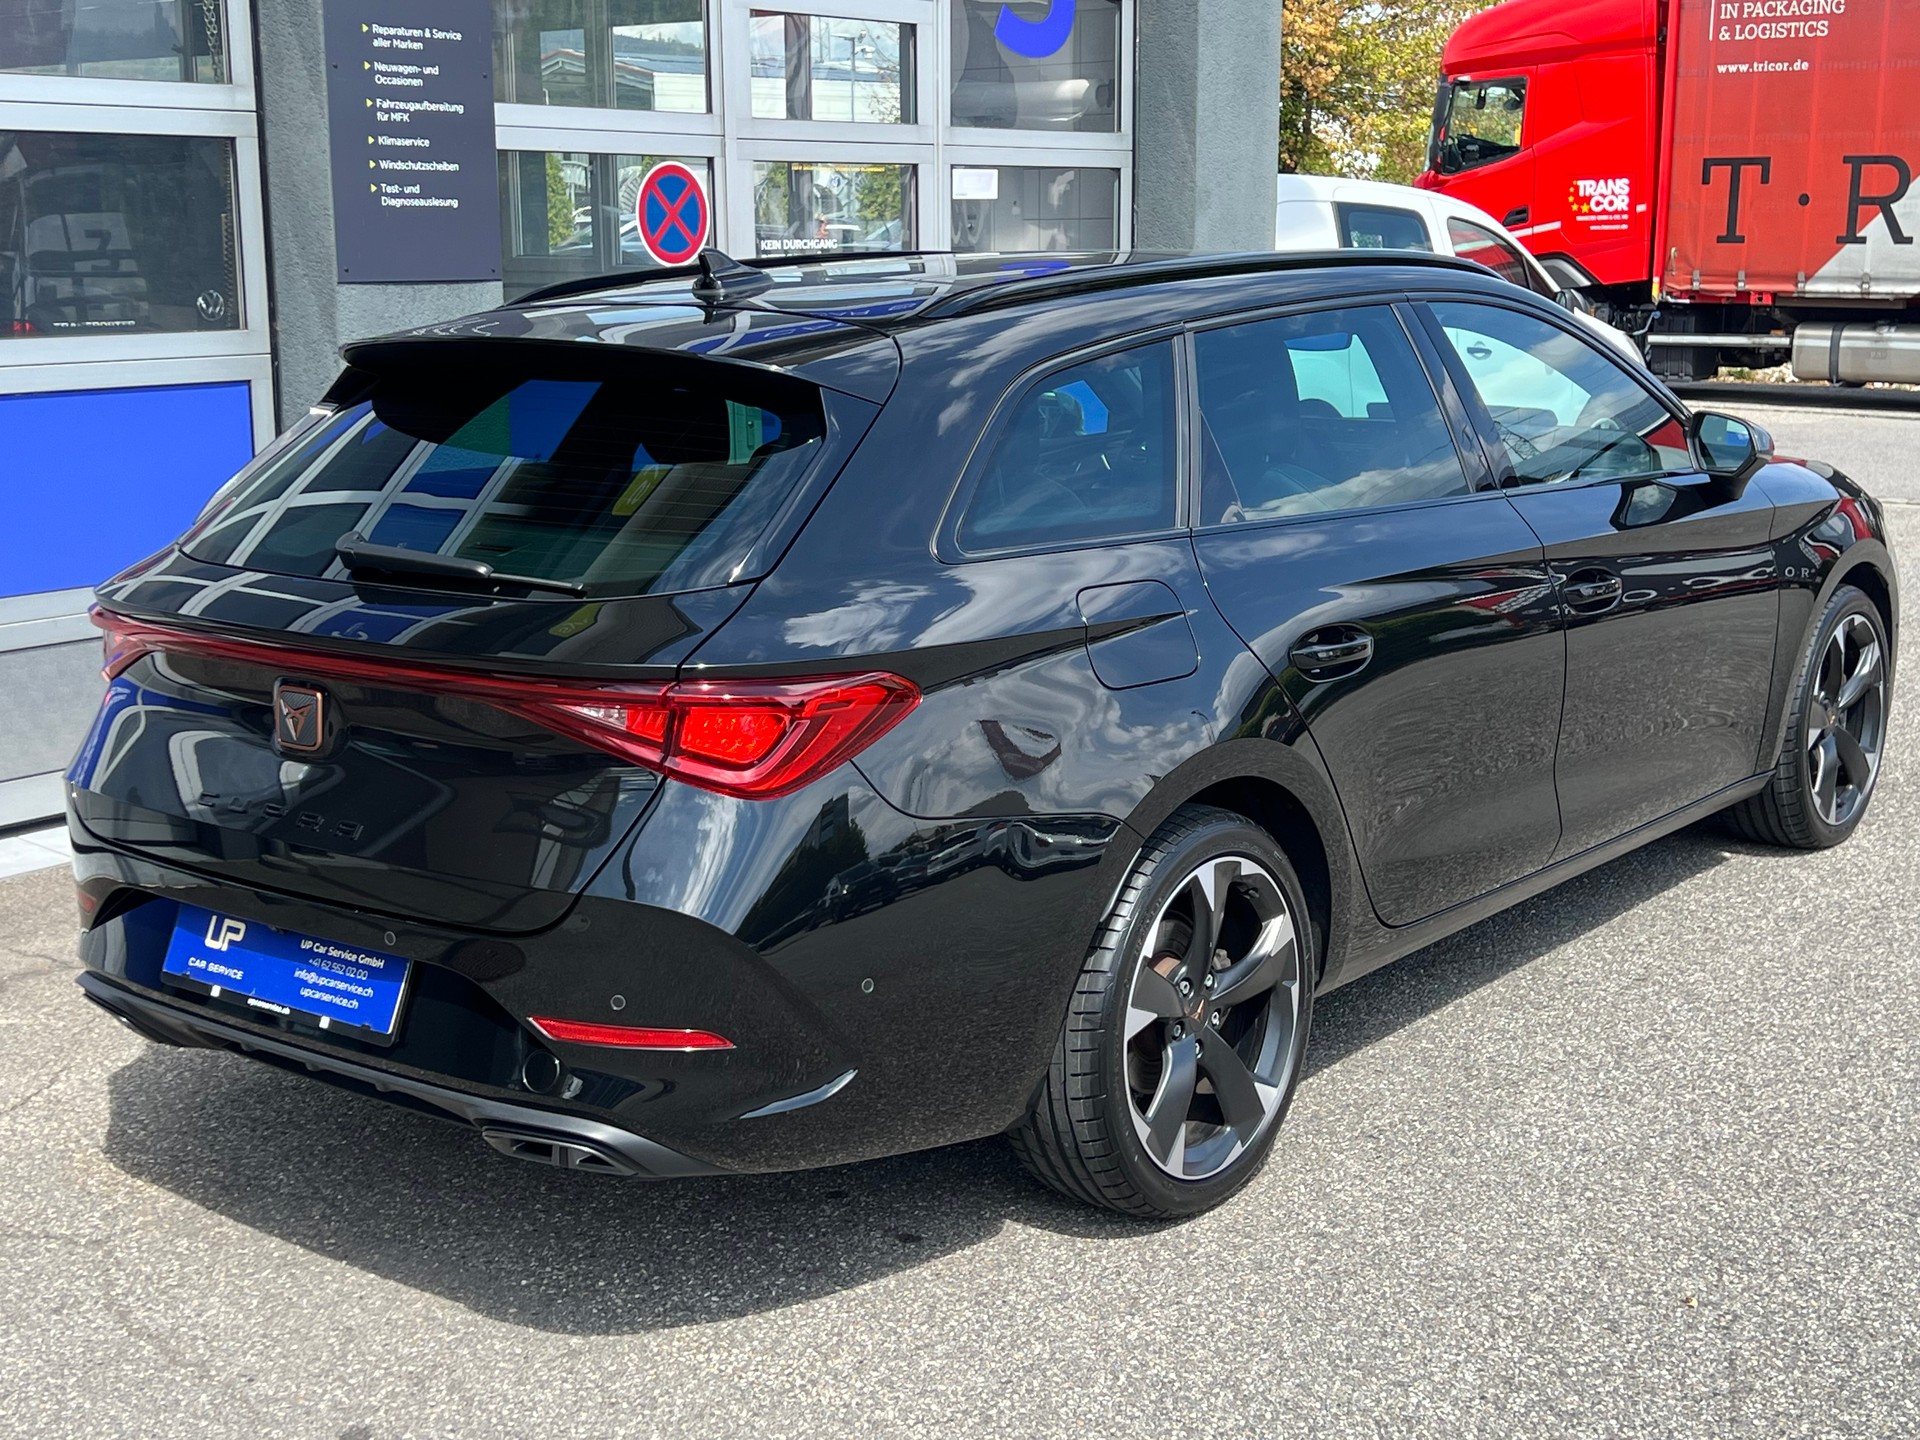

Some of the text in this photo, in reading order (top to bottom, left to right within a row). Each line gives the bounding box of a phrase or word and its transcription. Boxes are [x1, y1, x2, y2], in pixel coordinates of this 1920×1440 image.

[1719, 0, 1846, 19] IN PACKAGING
[372, 23, 462, 41] Reparaturen & Service
[1718, 20, 1829, 41] & LOGISTICS
[372, 38, 423, 50] aller Marken
[373, 61, 439, 75] Neuwagen- und
[1716, 58, 1809, 74] www.tricor.de
[374, 74, 424, 87] Occasionen
[376, 98, 464, 114] Fahrzeugaufbereitung
[376, 111, 410, 122] für MFK
[378, 135, 430, 148] Klimaservice
[379, 159, 460, 172] Windschutzscheiben
[380, 183, 420, 194] Test- und
[1577, 177, 1630, 197] TRANS
[381, 195, 459, 209] Diagnoseauslesung
[1589, 194, 1630, 213] COR
[760, 238, 838, 250] KEIN DURCHGANG
[204, 914, 247, 952] UP
[300, 939, 385, 969] UP Car Service GmbH
[187, 956, 245, 980] CAR SERVICE
[308, 957, 322, 968] +41
[320, 959, 332, 972] 62
[345, 966, 356, 978] 02
[356, 968, 369, 980] 00
[293, 968, 374, 998] info@upcarservice.ch
[300, 986, 359, 1009] upcarservice.ch
